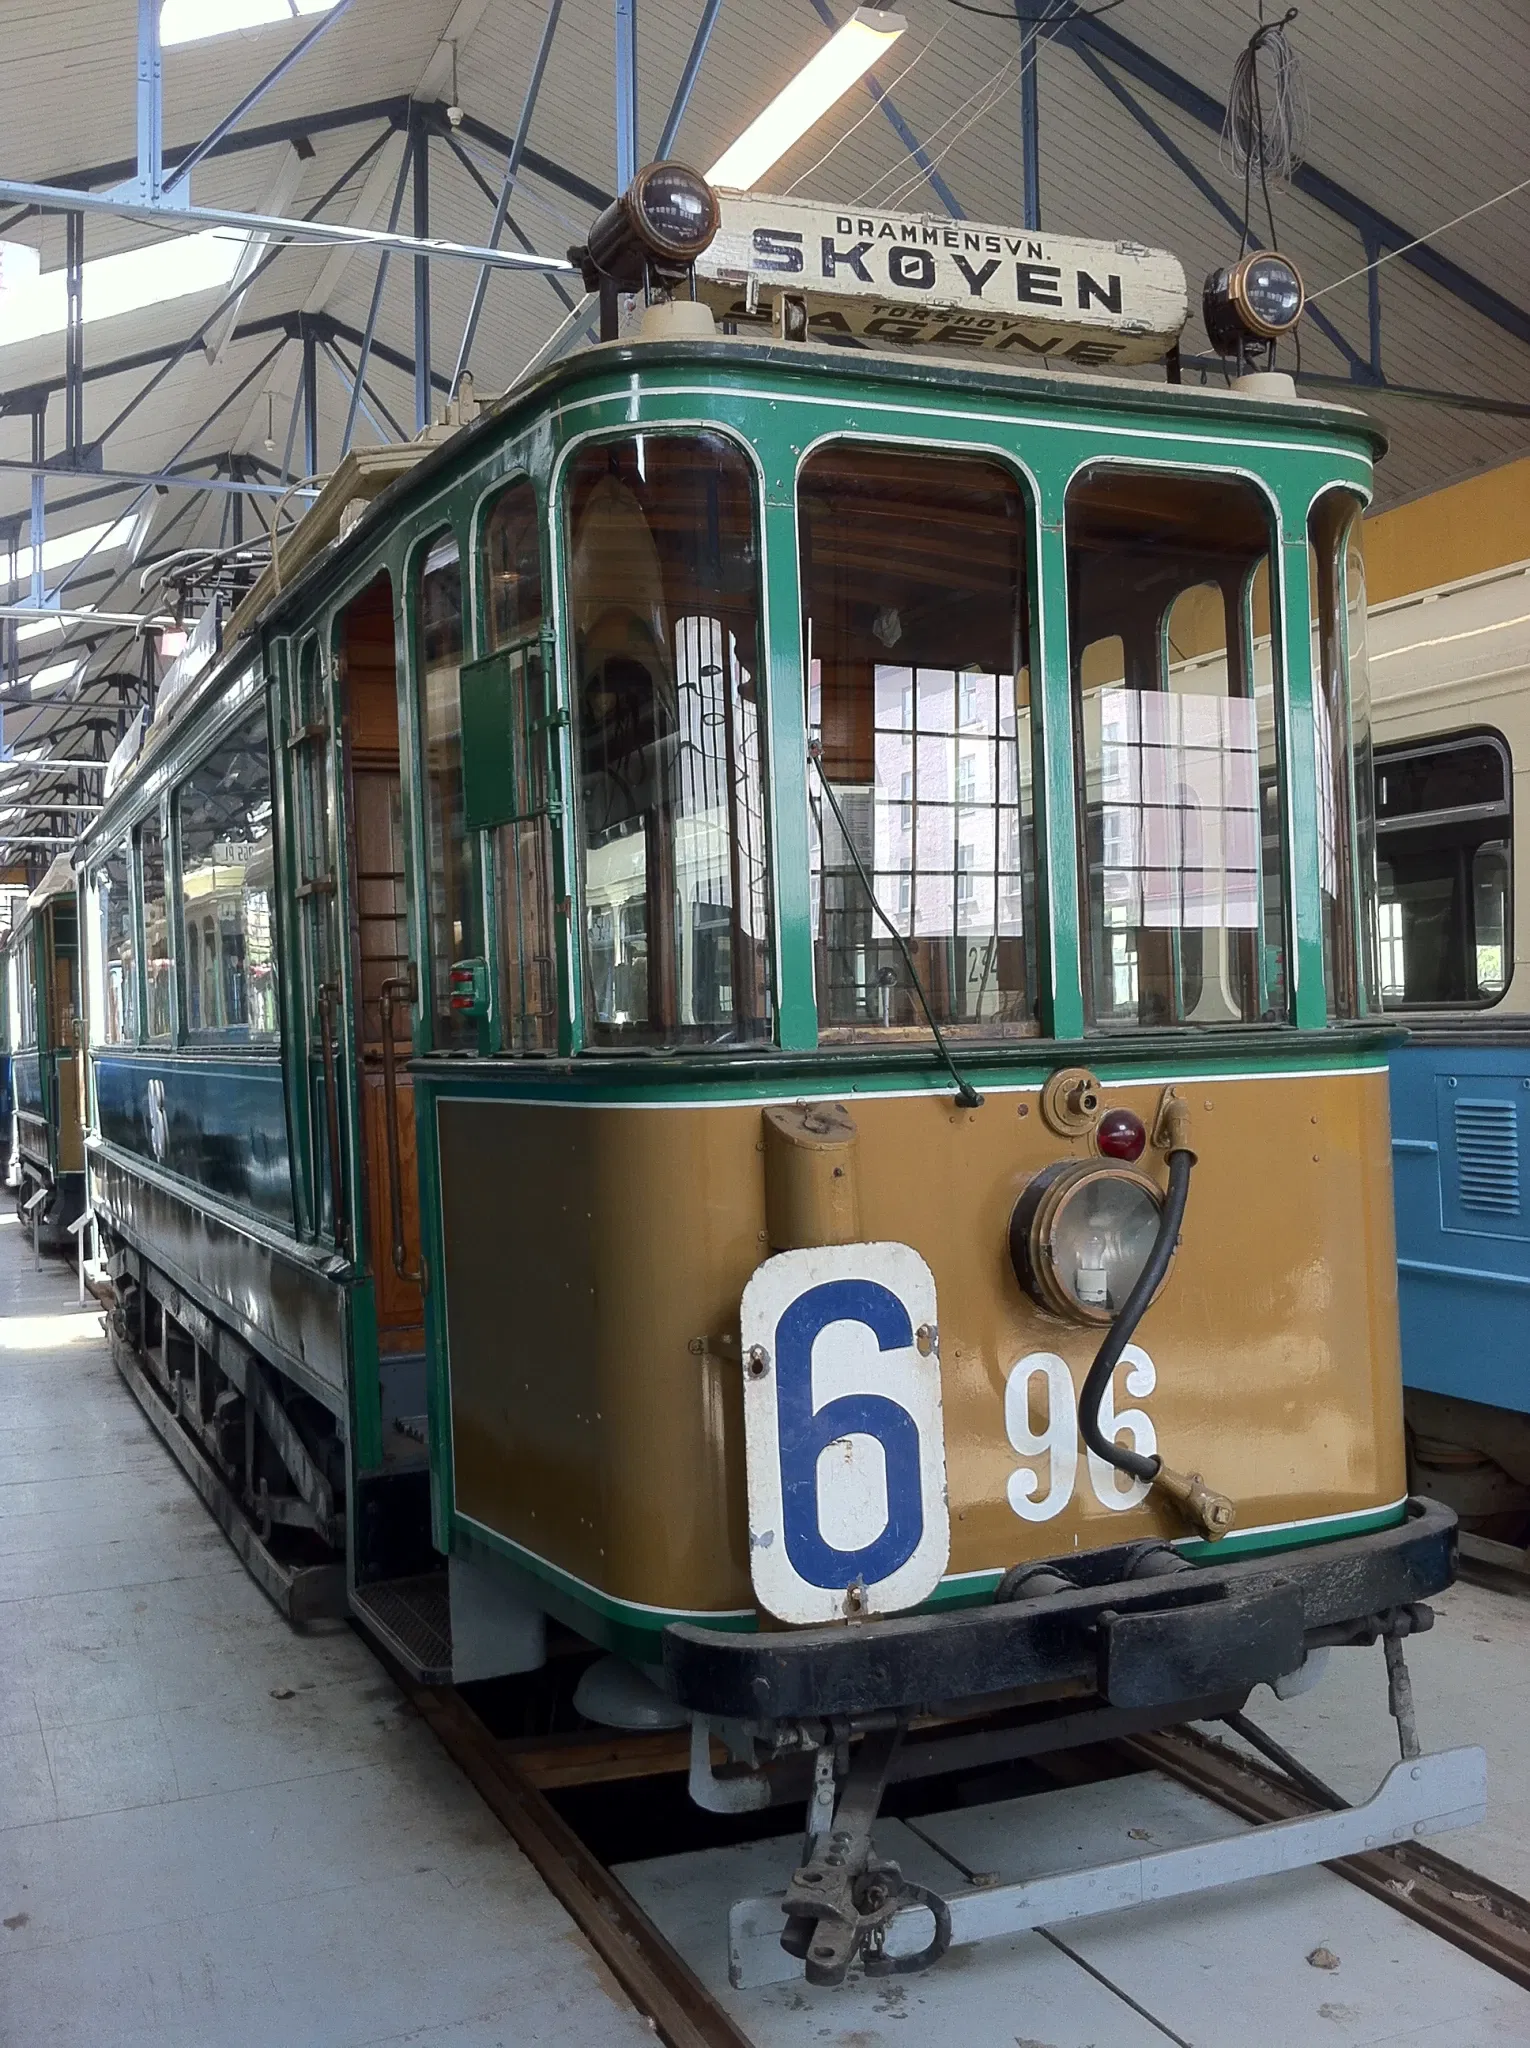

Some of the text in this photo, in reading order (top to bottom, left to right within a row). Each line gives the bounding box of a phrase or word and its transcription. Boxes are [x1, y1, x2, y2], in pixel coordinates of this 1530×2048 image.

[752, 228, 1122, 314] SKØYEN
[836, 216, 1051, 261] DRAMMENSVN.
[723, 301, 1126, 363] SAGENE
[871, 304, 1022, 331] TORSHOV
[775, 1279, 924, 1589] 6
[1004, 1343, 1157, 1522] 96
